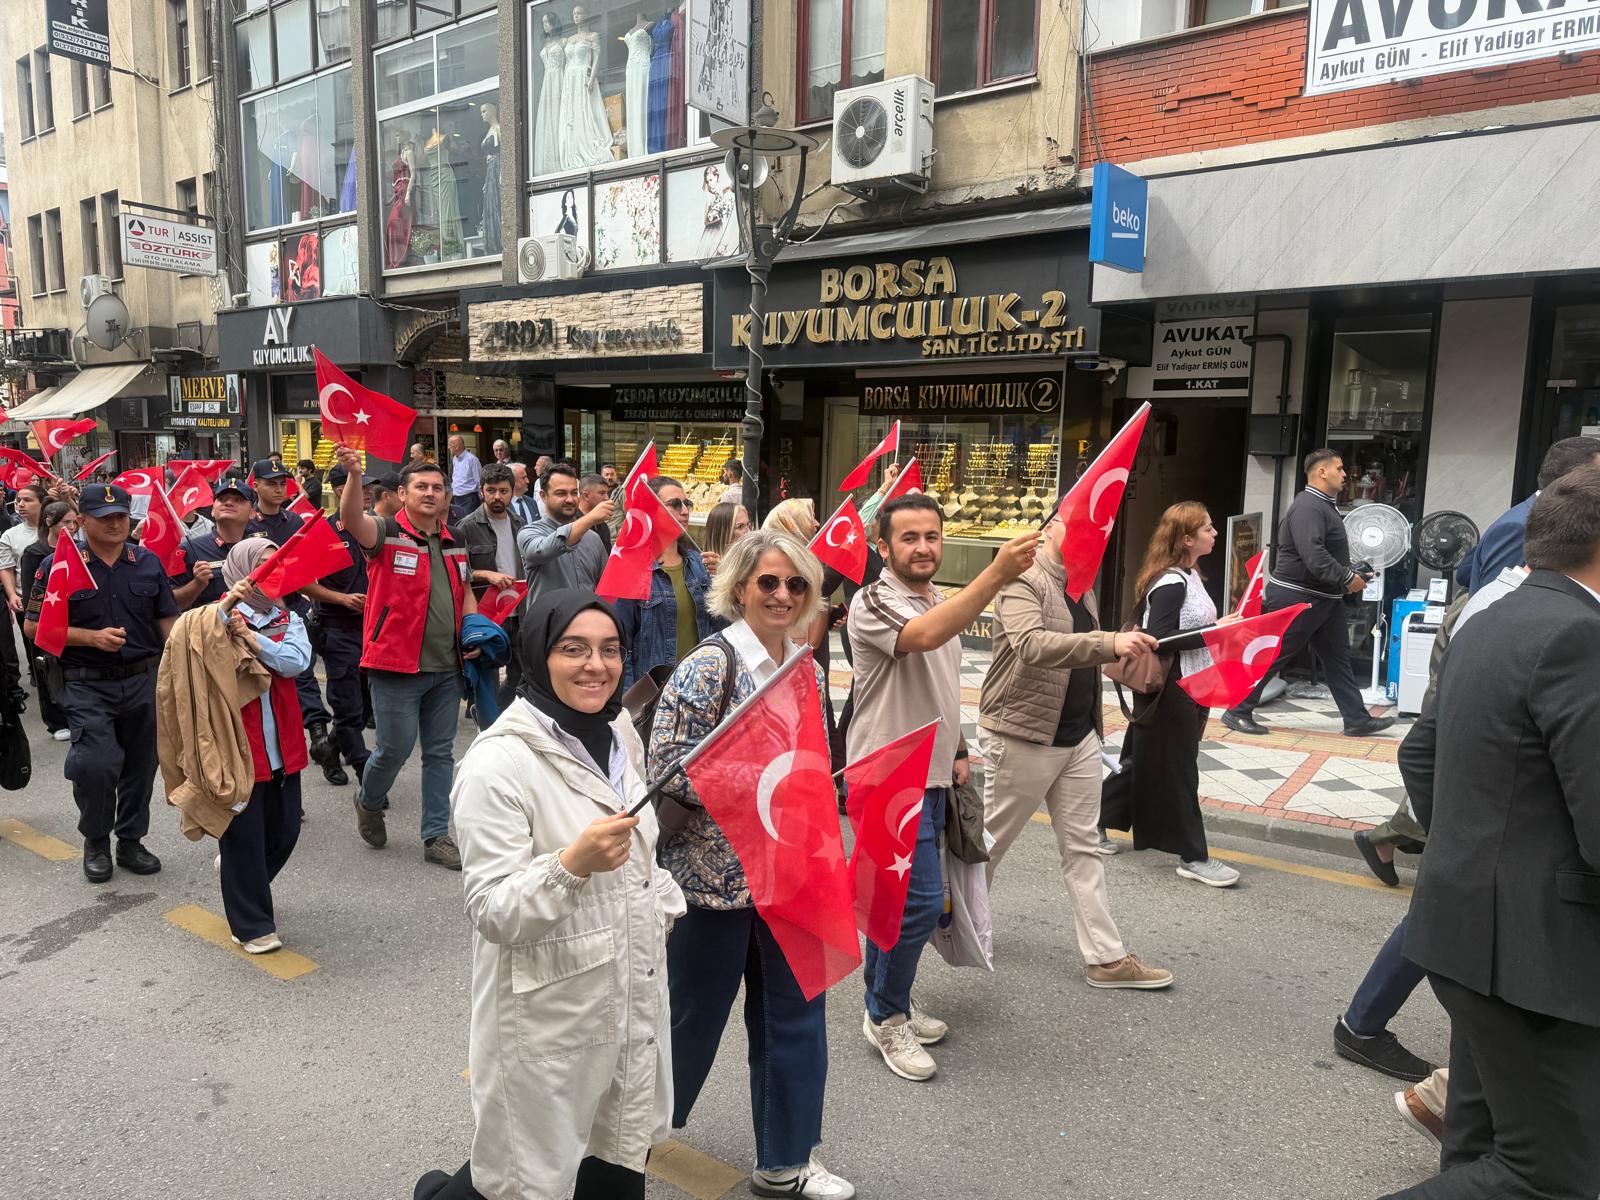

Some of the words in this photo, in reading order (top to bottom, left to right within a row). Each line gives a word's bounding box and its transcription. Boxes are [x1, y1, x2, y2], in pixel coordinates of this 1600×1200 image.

[1320, 57, 1364, 81] Aykut
[1375, 46, 1411, 72] GÜN
[1438, 38, 1469, 60] Elif
[1474, 25, 1546, 53] Yadigar
[1112, 201, 1140, 232] beko
[147, 225, 169, 238] TUR
[178, 231, 213, 246] ASSIST
[820, 256, 957, 303] BORSA
[263, 306, 293, 345] AY
[731, 290, 1067, 347] KUYUMCULUK-2
[480, 318, 554, 349] ZERDA
[1162, 325, 1249, 343] AVUKAT
[252, 345, 311, 366] KUYUMCULUK
[1170, 348, 1202, 359] Aykut
[1206, 345, 1232, 356] GÜN
[1156, 363, 1169, 371] Elif
[1171, 362, 1201, 372] Yadigar
[1202, 360, 1228, 371] ERMİŞ
[1230, 359, 1248, 369] GÜN
[181, 377, 226, 399] MERVE
[1185, 379, 1219, 389] 1.KAT
[615, 387, 656, 404] ZERDA
[863, 385, 911, 410] BORSA
[918, 382, 1030, 409] KUYUMCULUK
